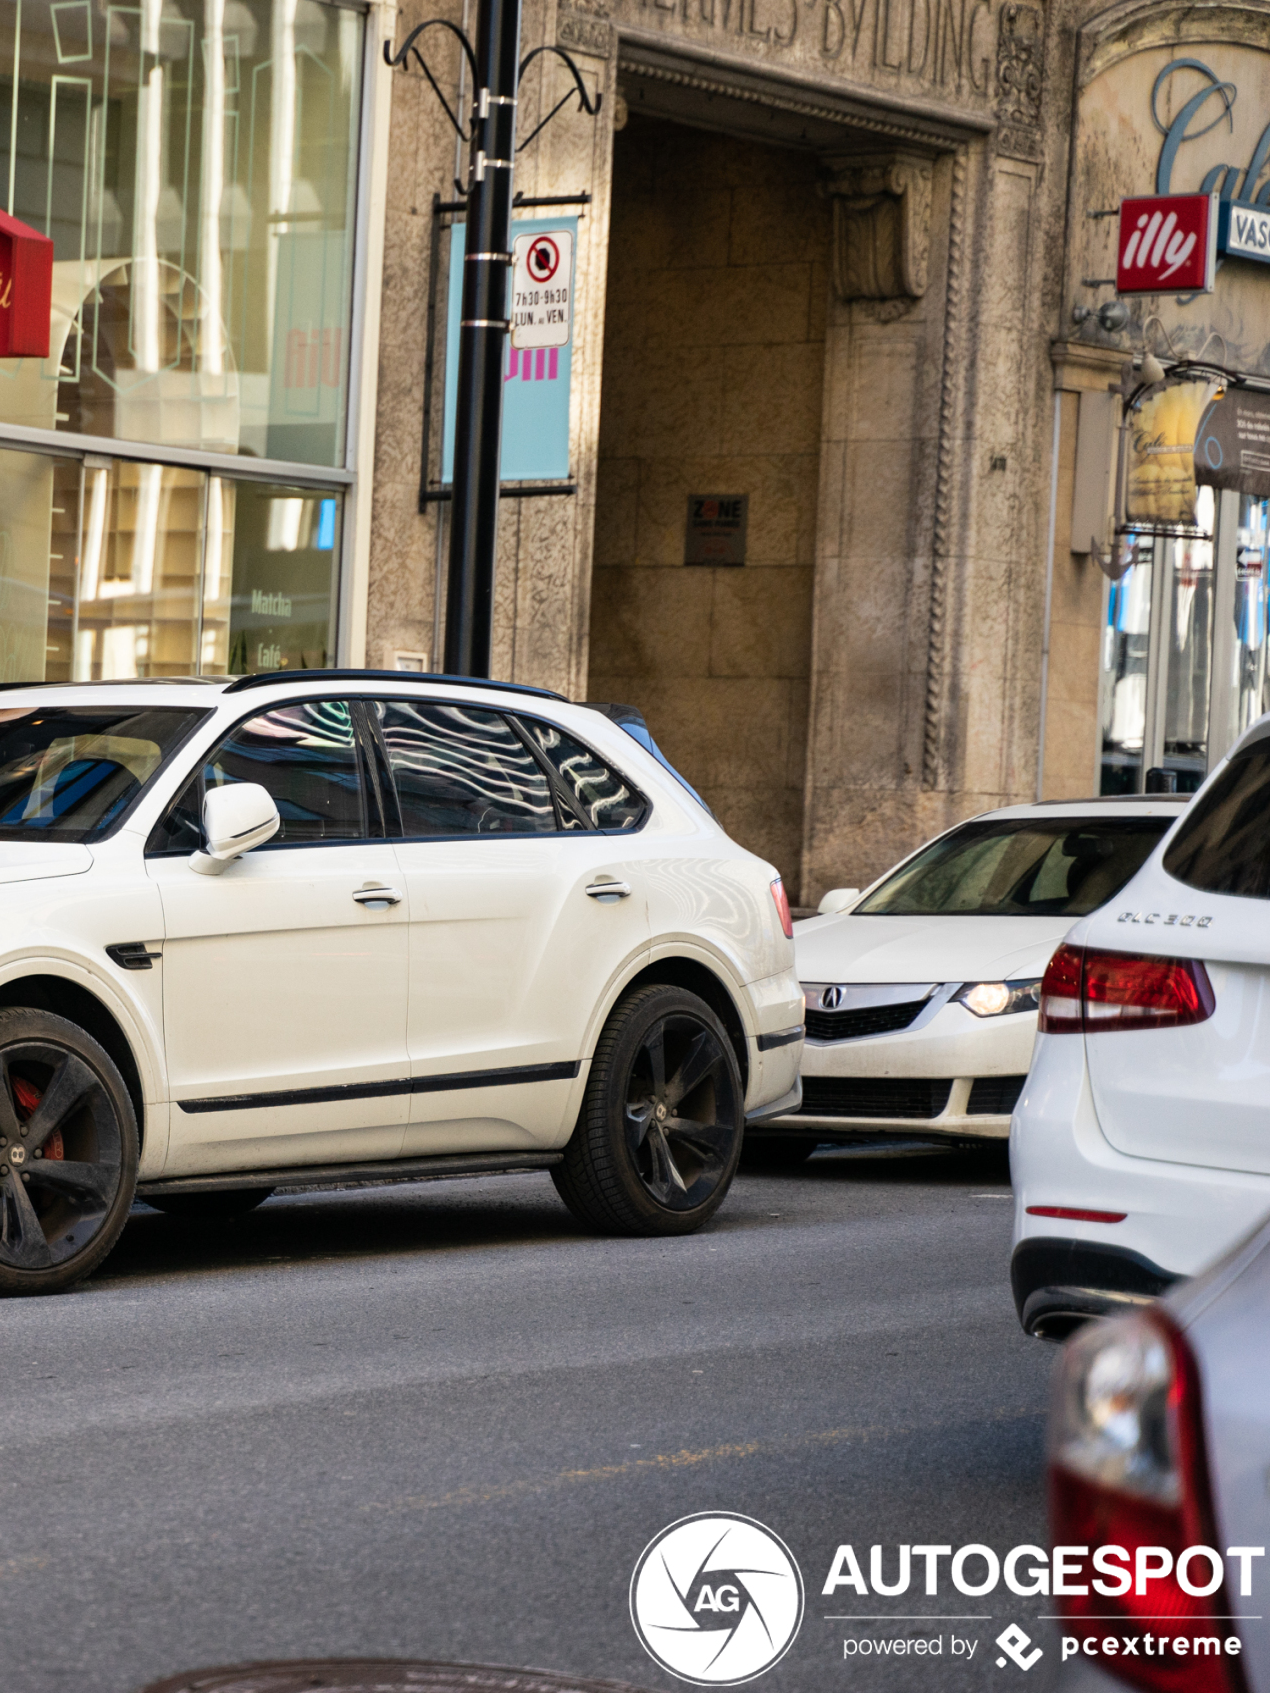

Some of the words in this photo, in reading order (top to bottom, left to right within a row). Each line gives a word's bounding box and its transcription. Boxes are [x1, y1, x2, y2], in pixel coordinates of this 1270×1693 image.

[1122, 210, 1198, 281] illy
[1235, 213, 1270, 250] VAS
[546, 309, 567, 325] VEN.
[251, 589, 292, 617] Matcha
[257, 643, 281, 669] Café
